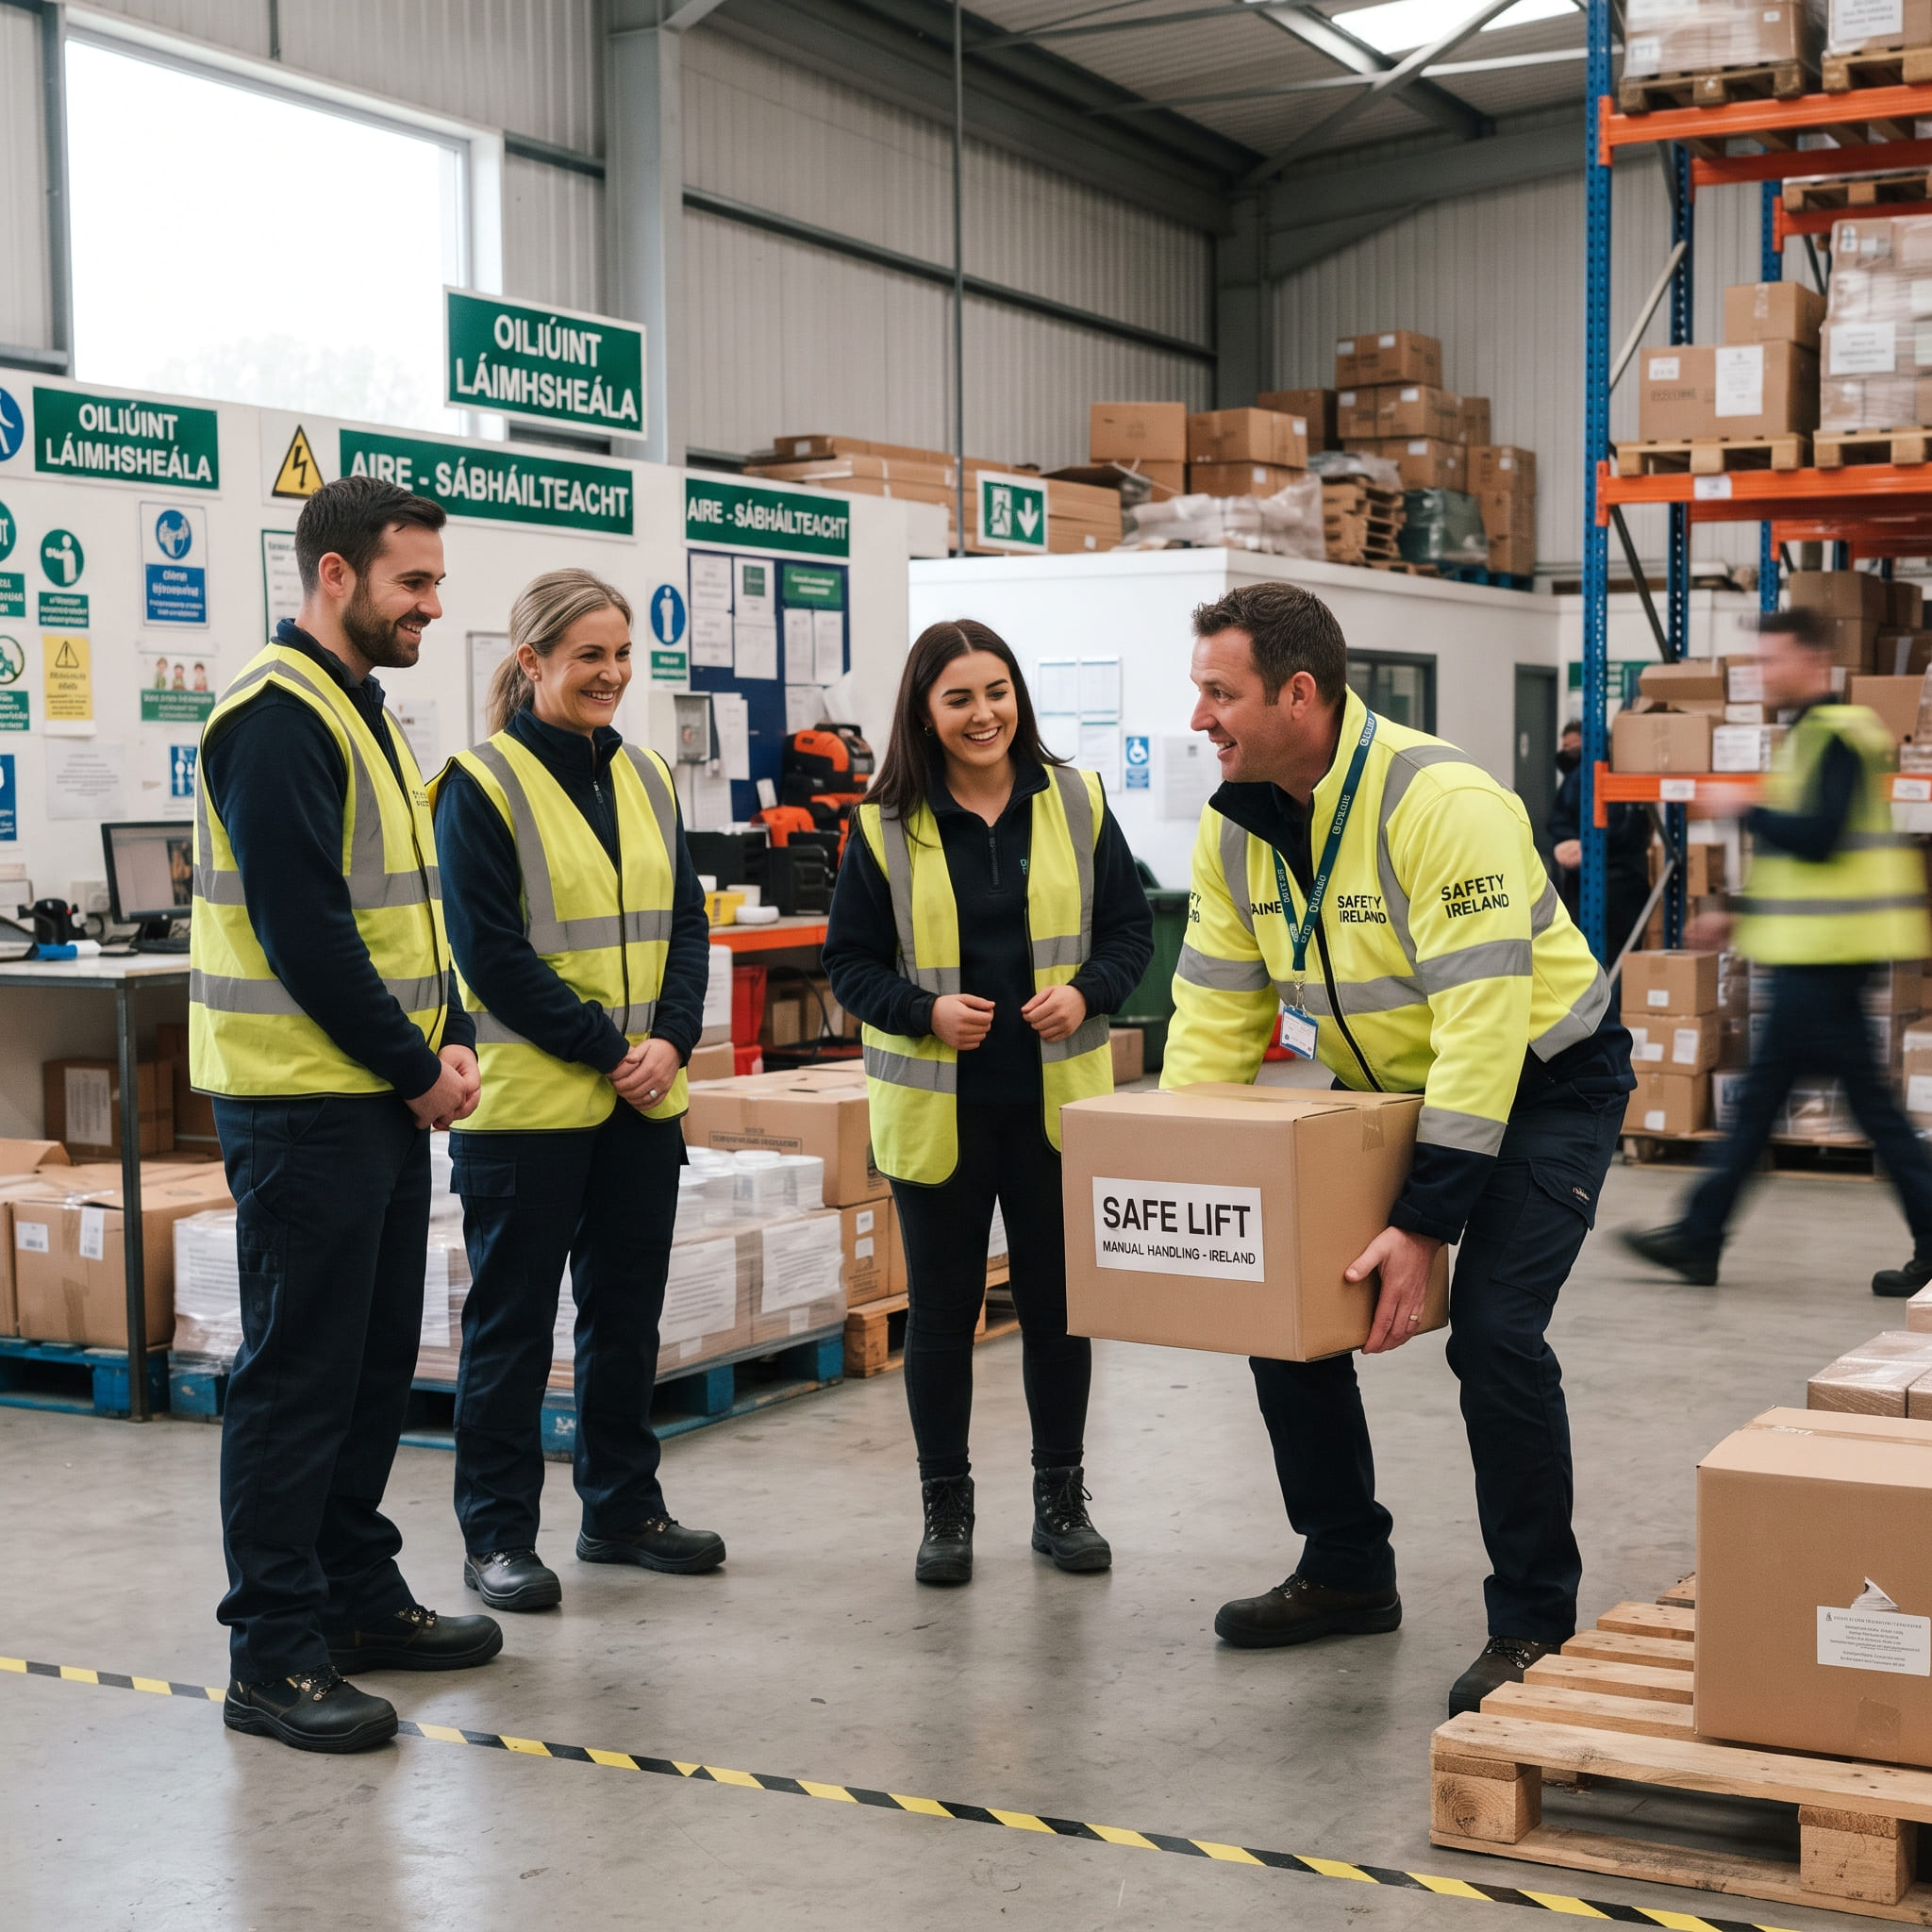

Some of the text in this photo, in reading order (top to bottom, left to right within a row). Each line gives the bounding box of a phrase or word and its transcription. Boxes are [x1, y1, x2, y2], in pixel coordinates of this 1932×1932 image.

[493, 314, 602, 368] OILIÚINT
[456, 353, 639, 423] LÁIMHSHEÁLA
[78, 402, 178, 441] OILIÚINT
[46, 432, 213, 482] LÁIMHSHEÁLA
[349, 451, 629, 518] AIRE - SÁBHÁILTEACHT
[687, 497, 724, 524] AIRE
[734, 499, 847, 540] SÁBHÁILTEACHT
[1337, 895, 1382, 909] SAFETY
[1441, 874, 1505, 902] SAFETY
[1445, 893, 1509, 919] IRELAND
[1340, 910, 1387, 924] IRELAND
[1103, 1196, 1251, 1238] SAFE LIFT
[1103, 1241, 1144, 1256] MANUAL
[1147, 1244, 1200, 1260] HANDLING
[1209, 1250, 1256, 1265] IRELAND
